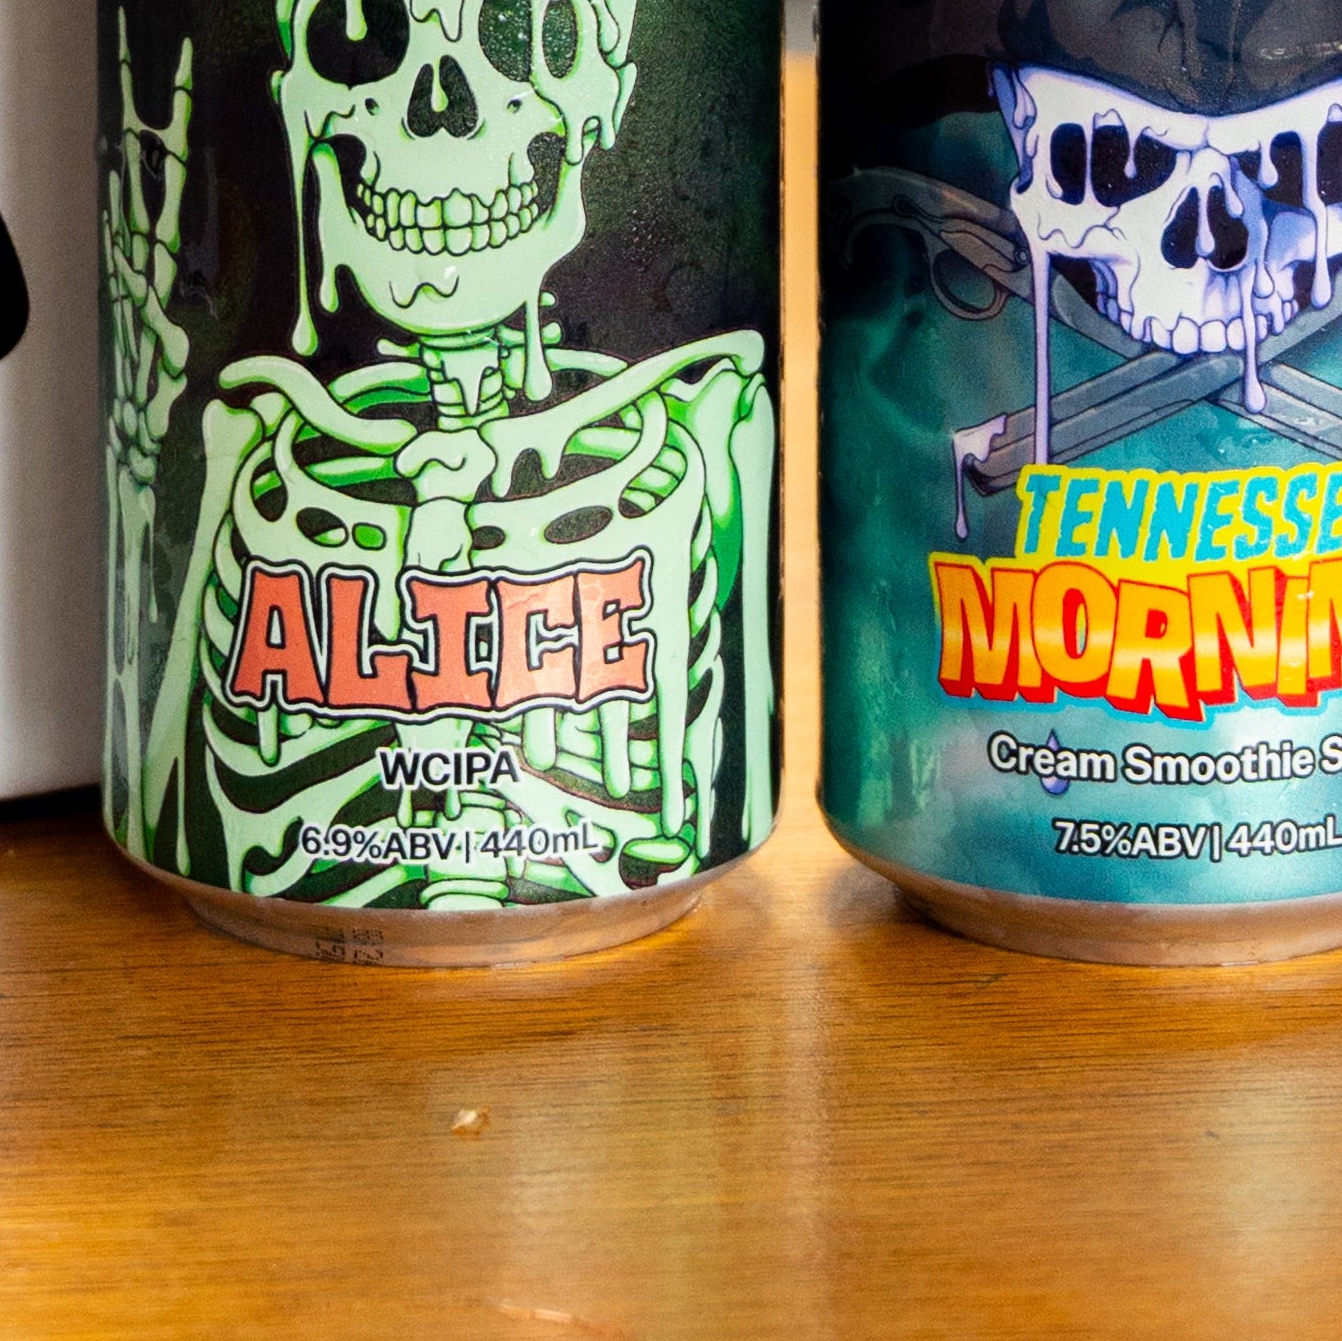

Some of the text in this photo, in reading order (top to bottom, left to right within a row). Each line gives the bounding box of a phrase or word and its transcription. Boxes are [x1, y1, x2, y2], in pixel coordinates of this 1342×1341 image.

[229, 555, 654, 714] ALICE
[988, 731, 1116, 781] Cream
[1122, 741, 1315, 784] Smoothie
